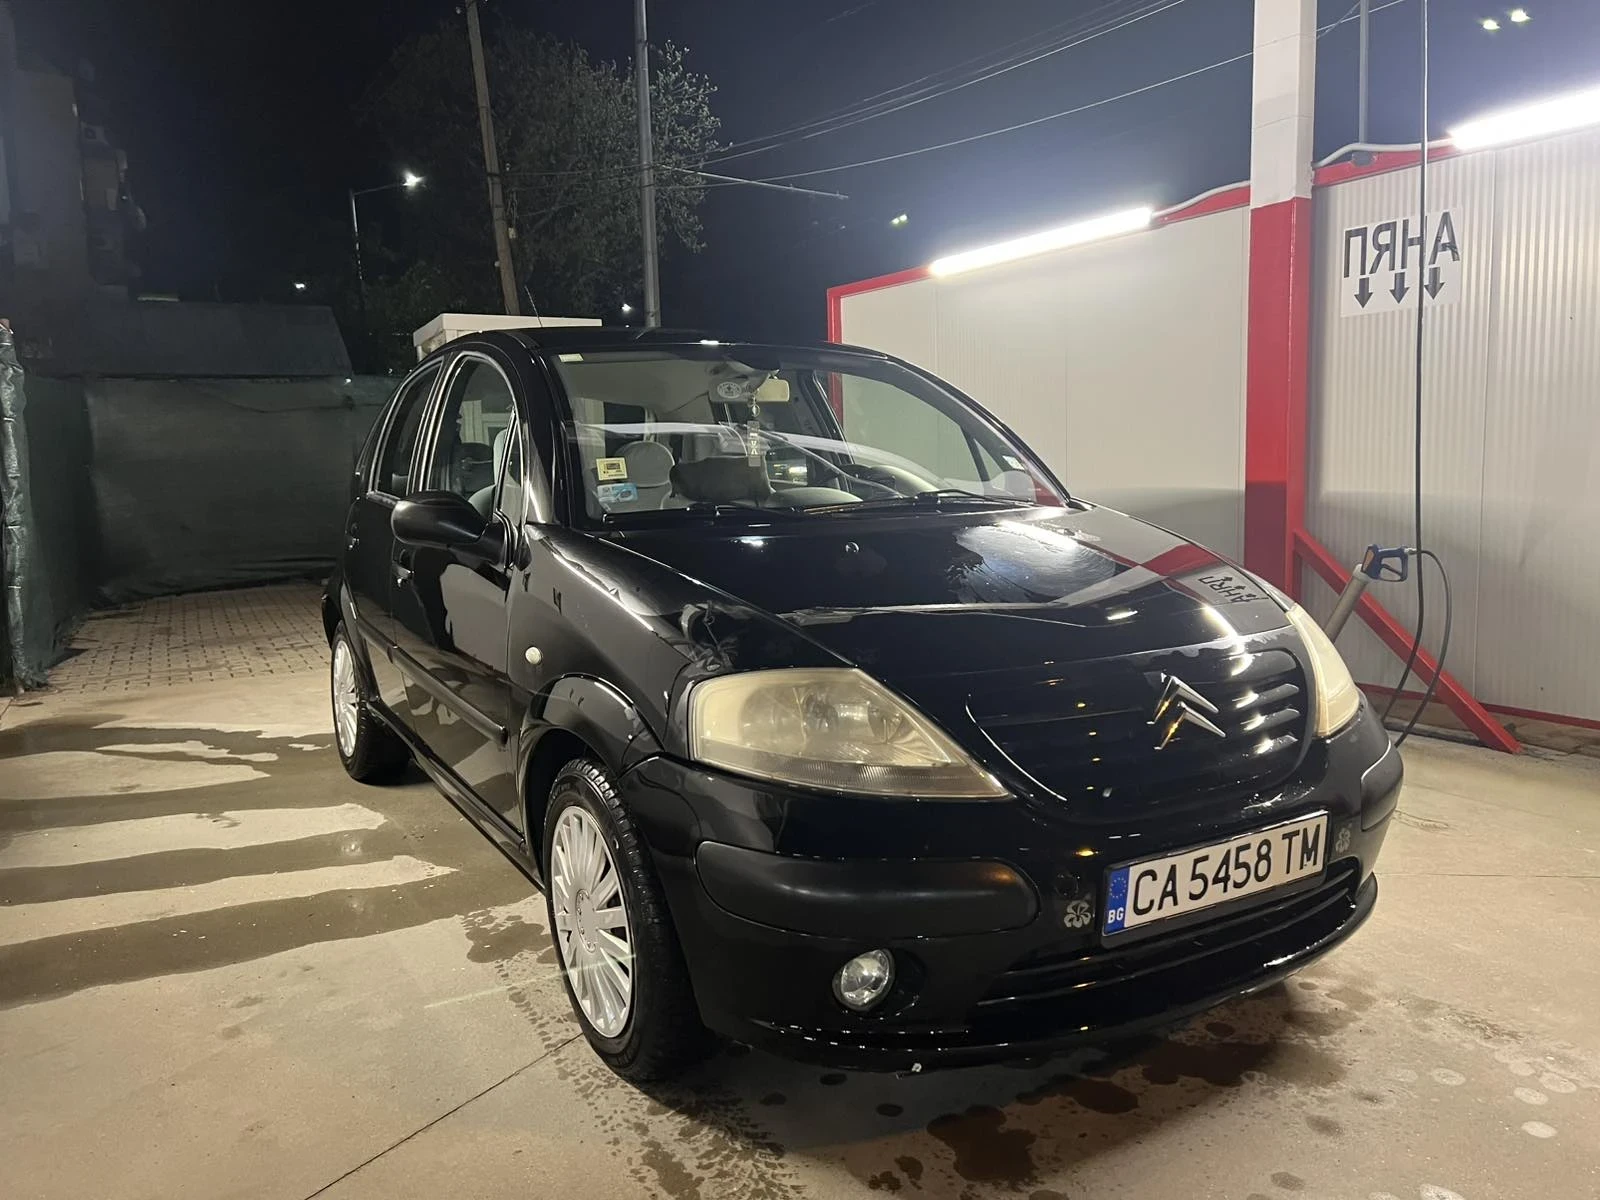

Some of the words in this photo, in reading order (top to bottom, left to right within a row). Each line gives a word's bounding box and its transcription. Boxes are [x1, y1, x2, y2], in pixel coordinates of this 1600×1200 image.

[1343, 211, 1460, 278] ПЯНА
[1132, 864, 1179, 916] CA
[1188, 838, 1272, 901] 5458
[1281, 823, 1321, 876] TM
[1107, 906, 1125, 924] BG
